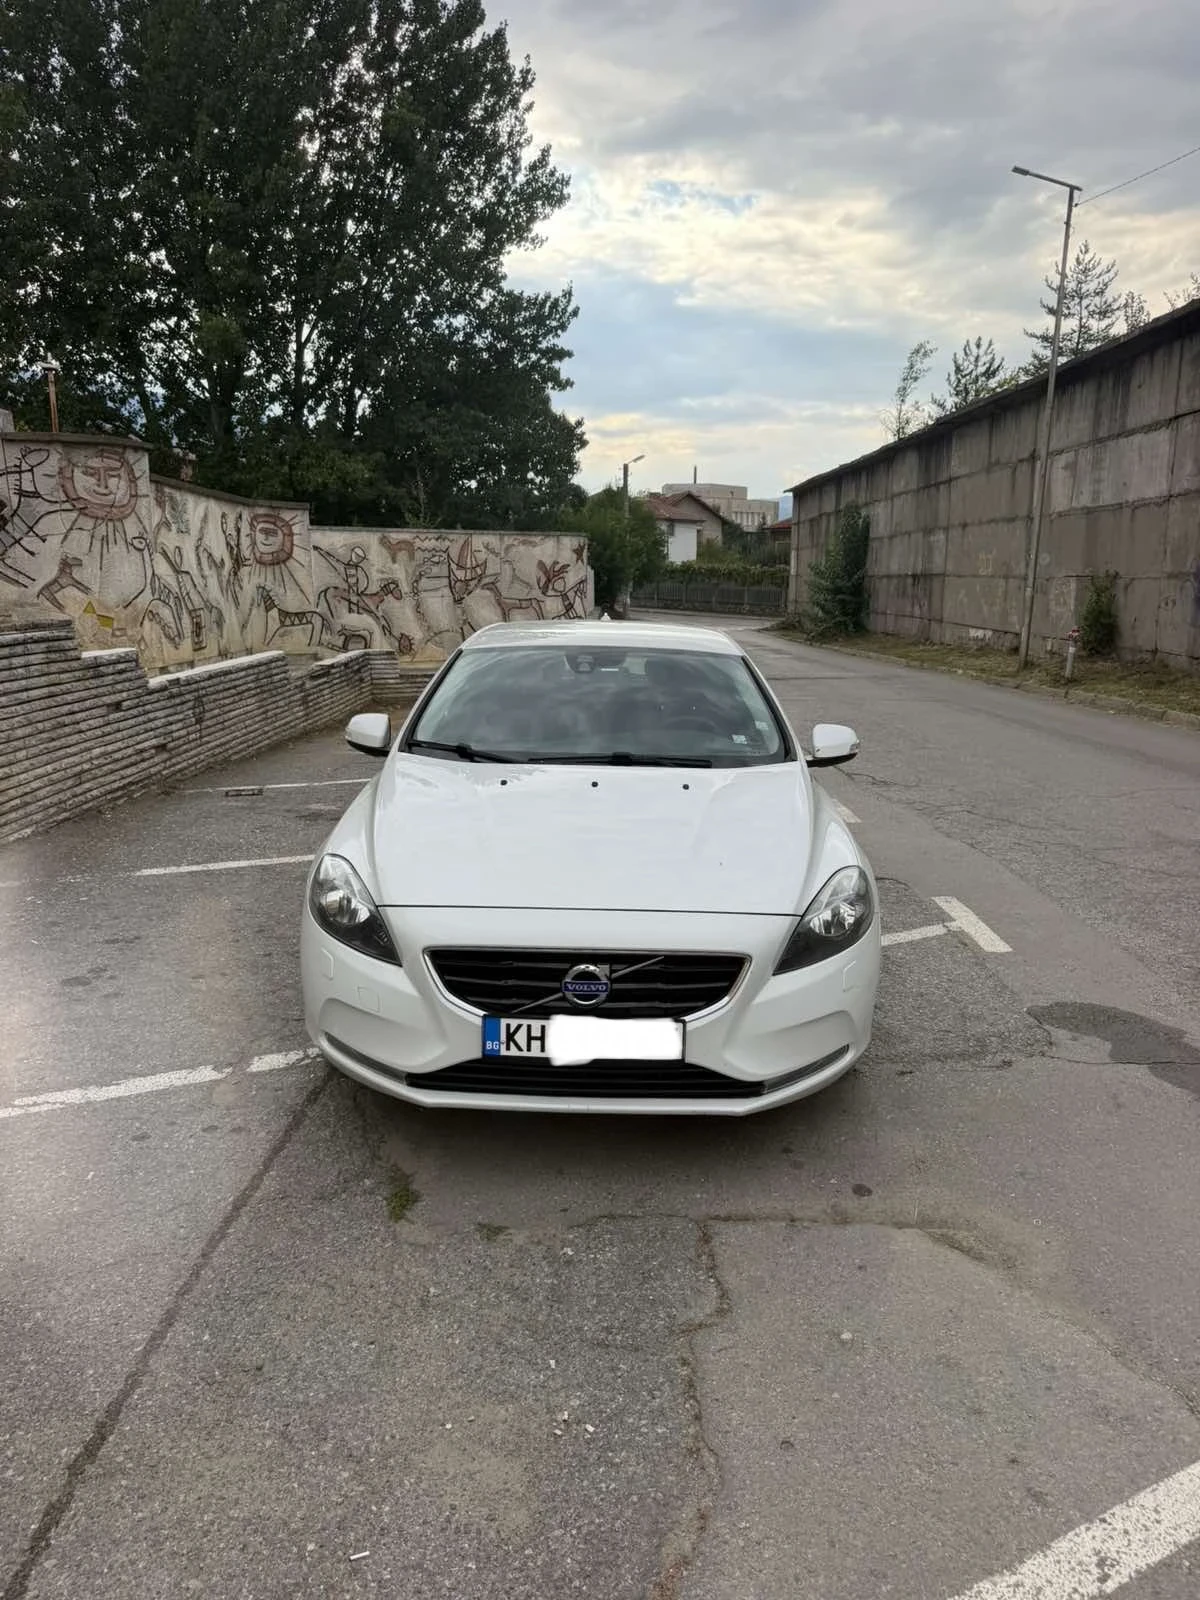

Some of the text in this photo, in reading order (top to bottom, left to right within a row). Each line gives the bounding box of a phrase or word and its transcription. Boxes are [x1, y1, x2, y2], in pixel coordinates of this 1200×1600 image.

[565, 983, 607, 991] VOLVO
[505, 1023, 546, 1053] KH
[486, 1041, 499, 1050] BG
